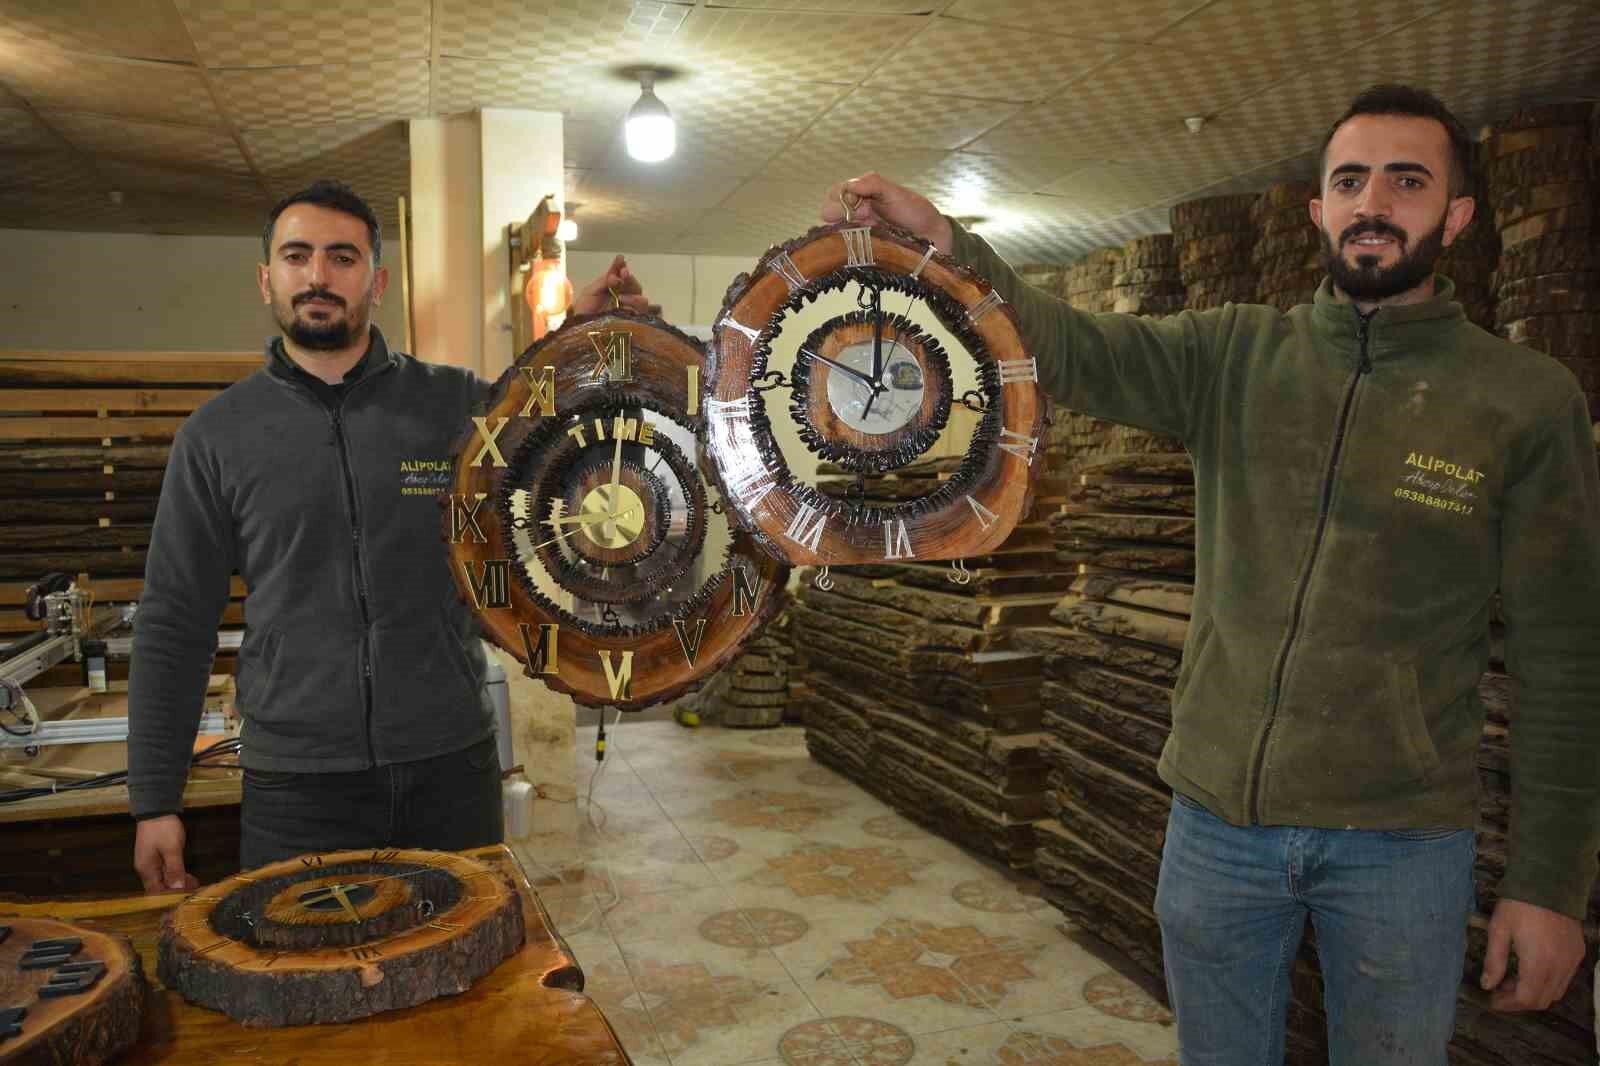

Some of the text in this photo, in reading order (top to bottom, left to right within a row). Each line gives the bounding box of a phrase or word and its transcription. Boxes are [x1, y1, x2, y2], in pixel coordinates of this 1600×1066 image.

[587, 331, 633, 383] XII
[518, 365, 557, 417] XI
[686, 364, 700, 417] I
[470, 416, 510, 468] X
[567, 415, 657, 449] TIME
[450, 492, 488, 544] IX
[672, 618, 707, 673] V
